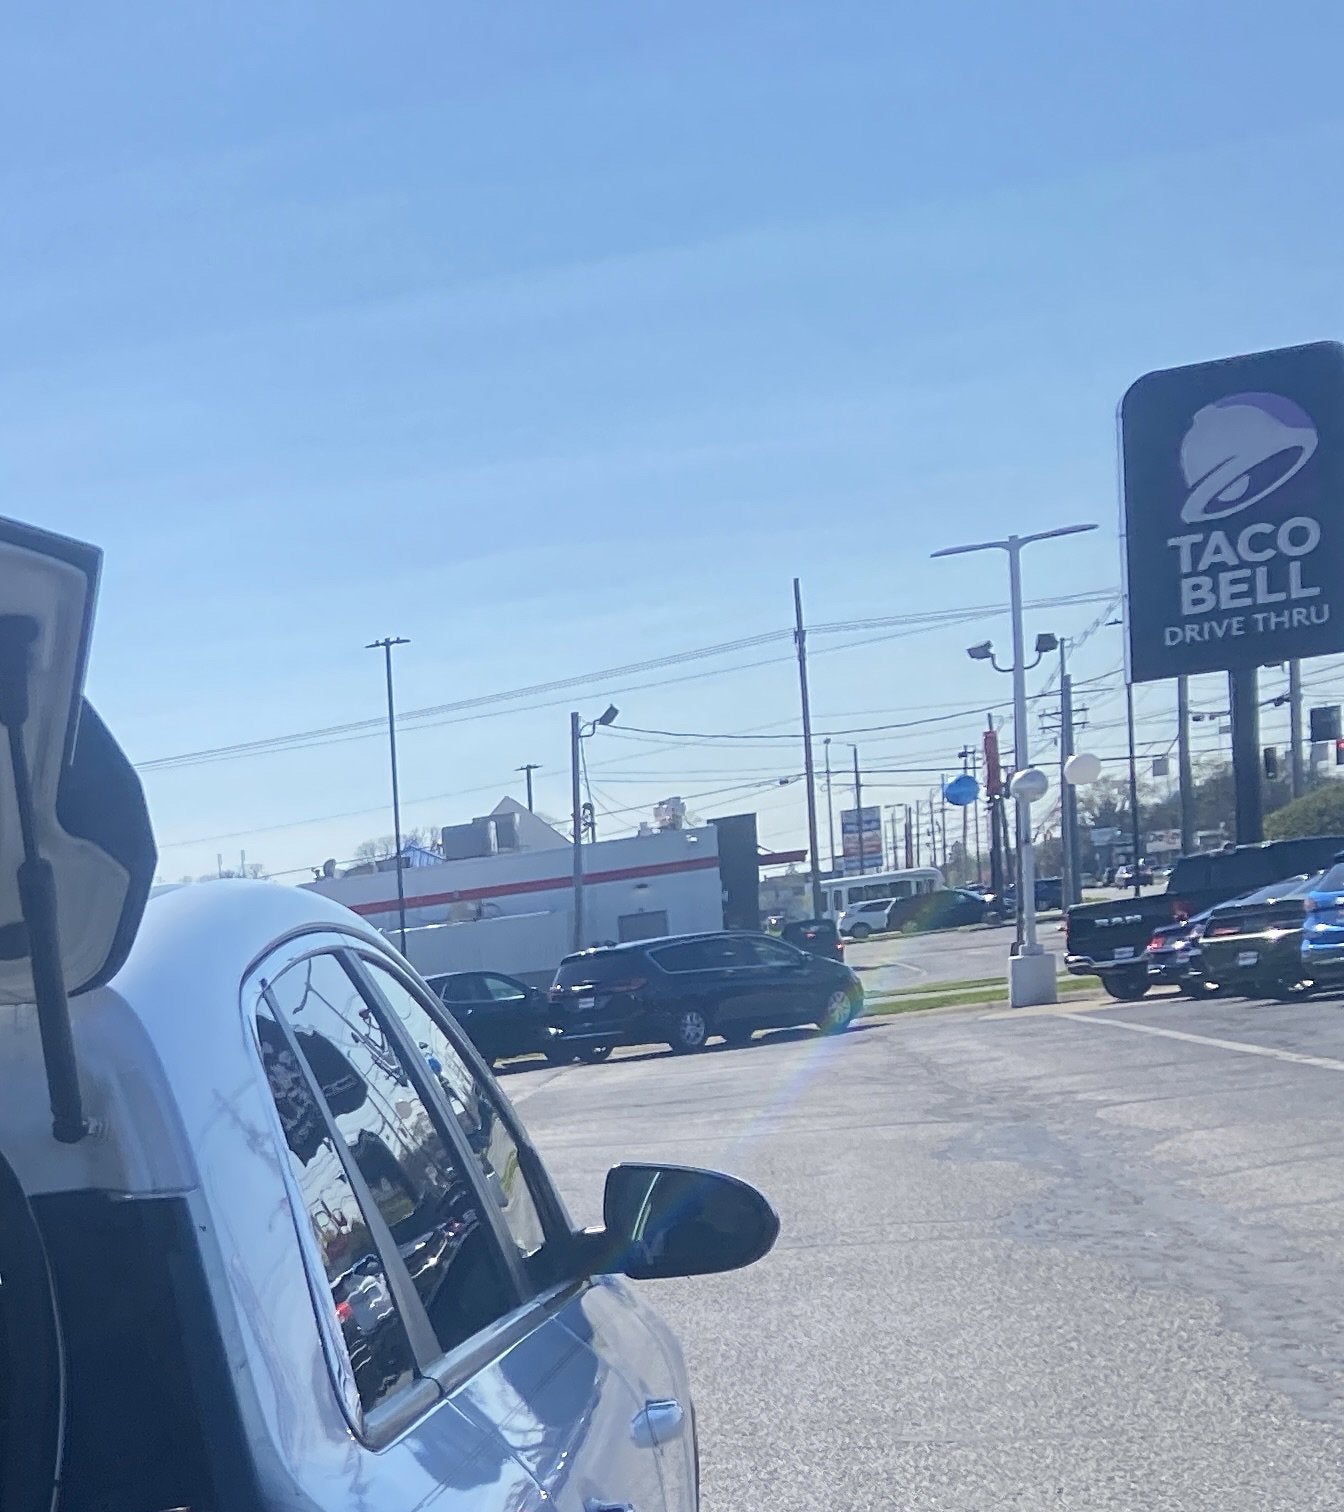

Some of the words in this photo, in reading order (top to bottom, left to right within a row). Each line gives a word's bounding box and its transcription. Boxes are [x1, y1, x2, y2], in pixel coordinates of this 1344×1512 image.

[1167, 516, 1321, 573] TACO
[1181, 561, 1321, 616] BELL
[1164, 616, 1245, 646] DRIVE
[1252, 604, 1330, 632] THRU
